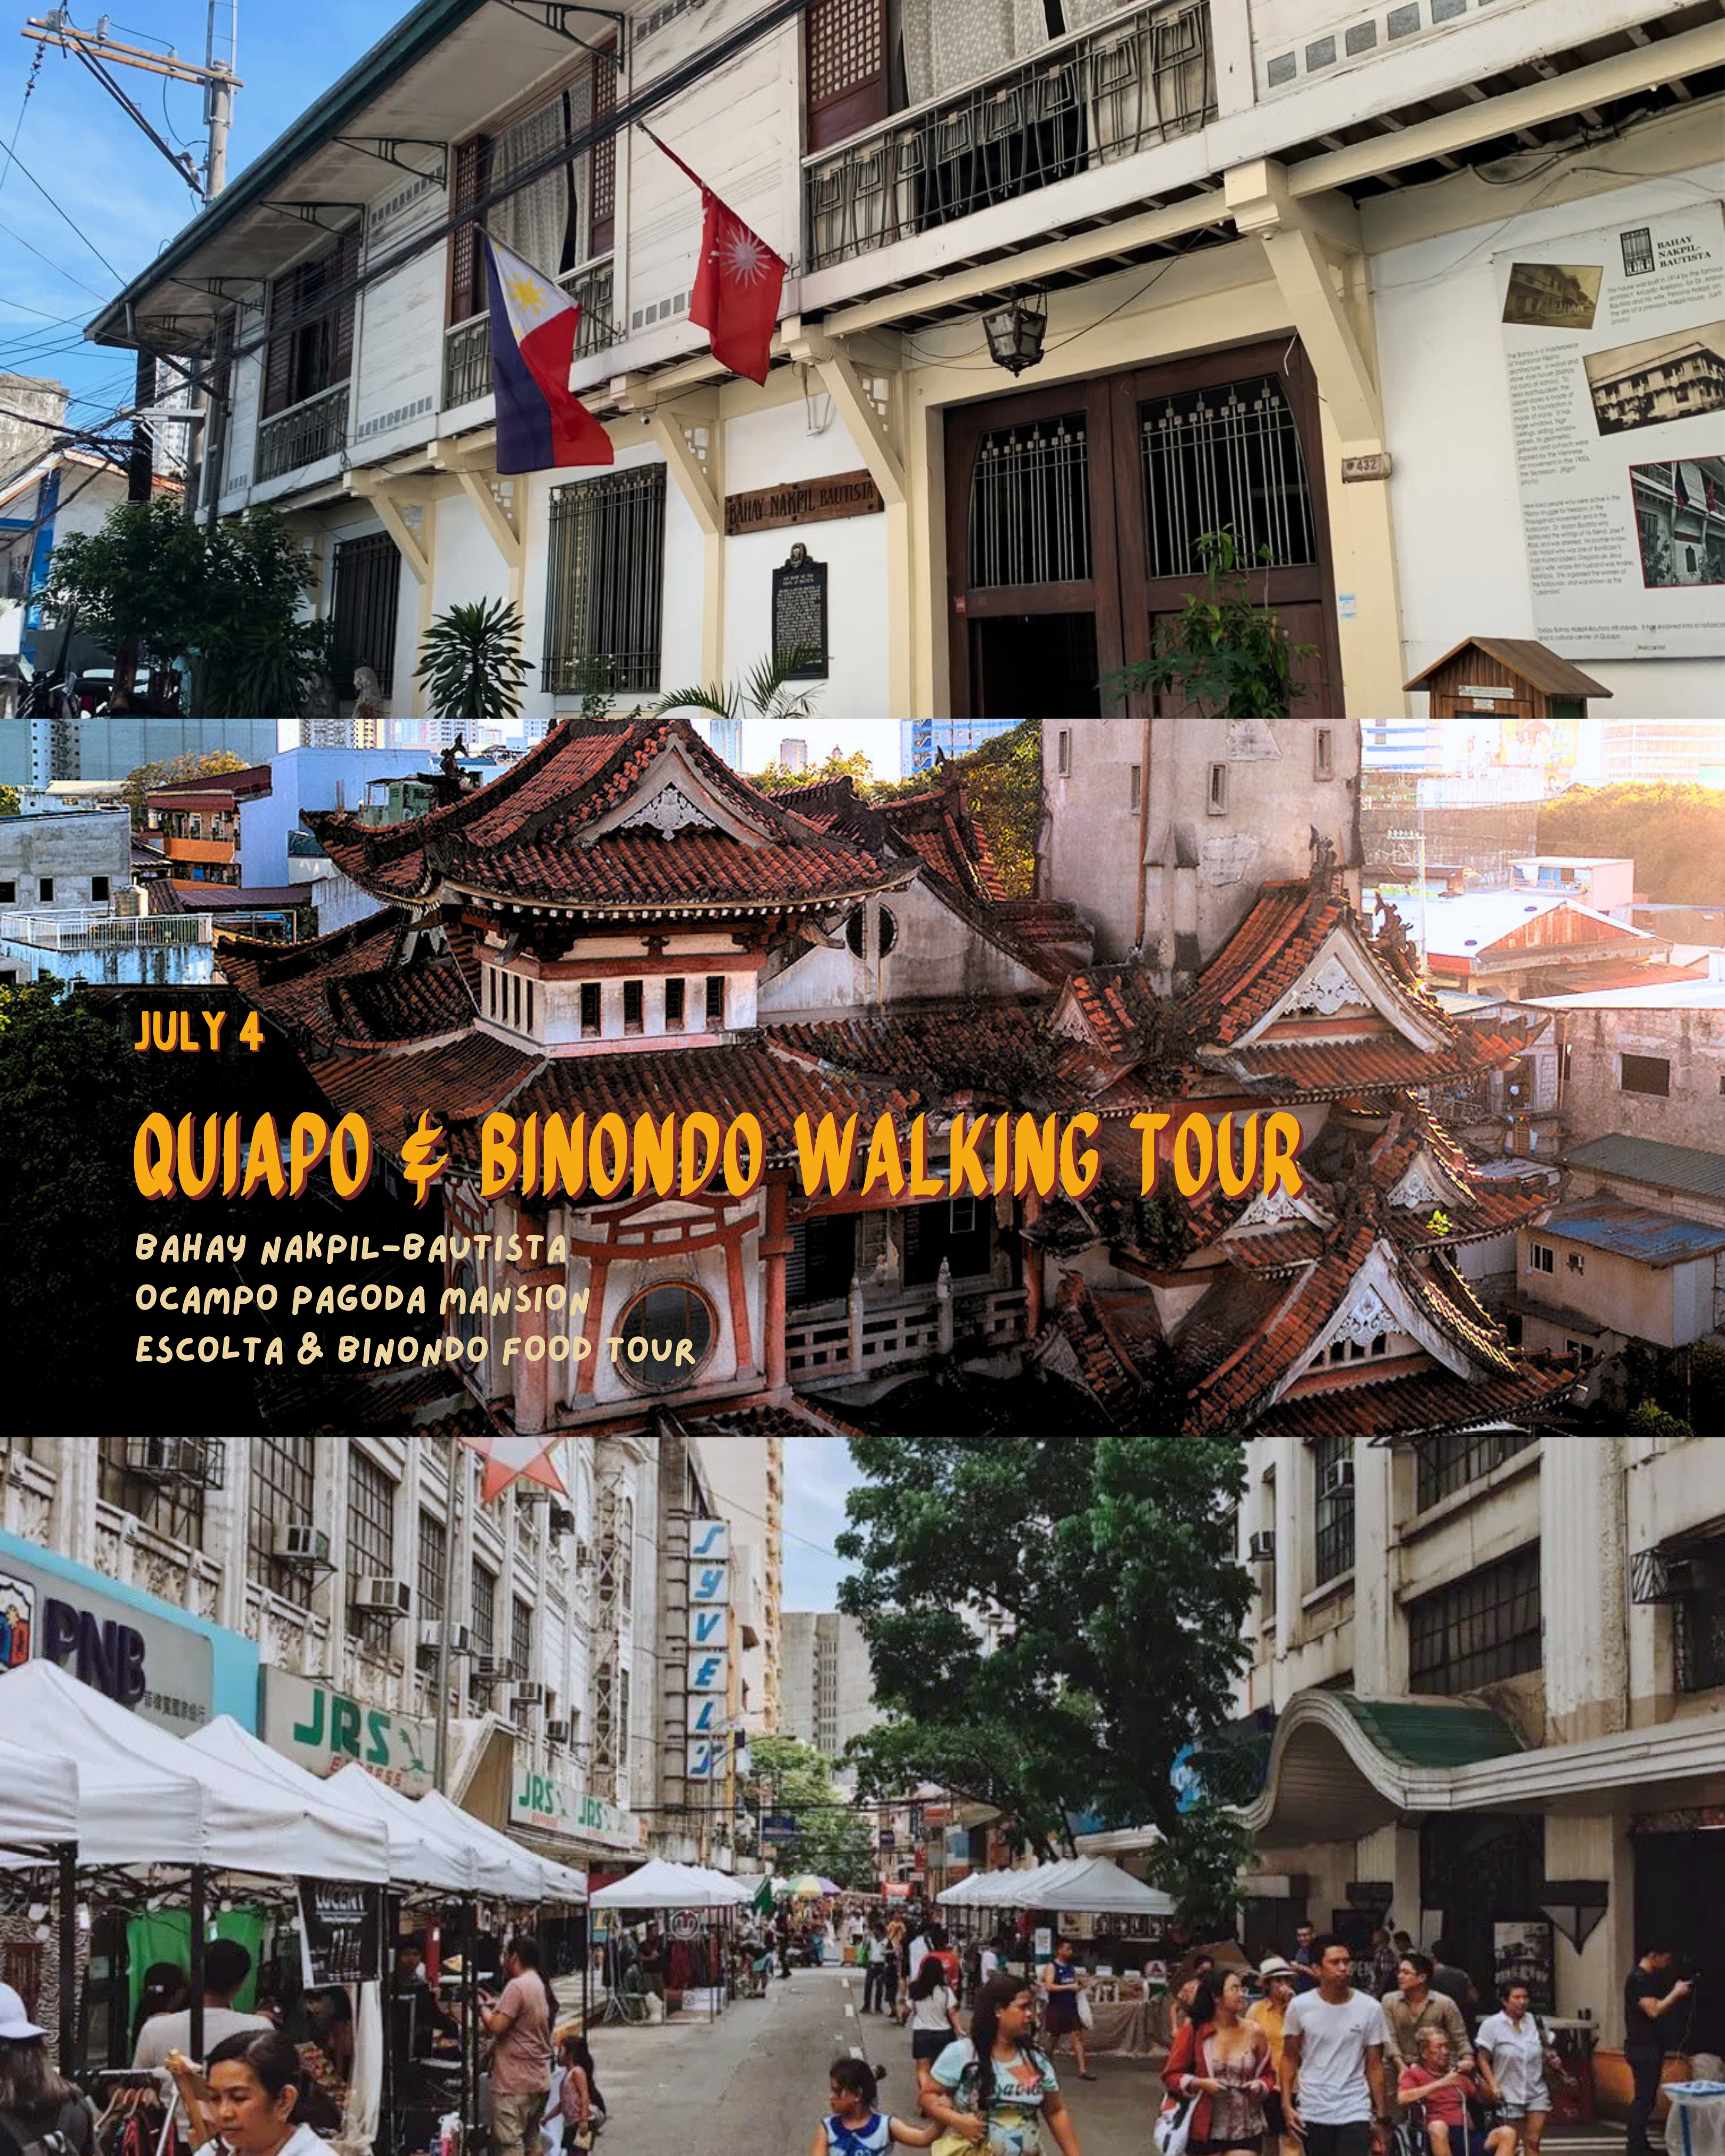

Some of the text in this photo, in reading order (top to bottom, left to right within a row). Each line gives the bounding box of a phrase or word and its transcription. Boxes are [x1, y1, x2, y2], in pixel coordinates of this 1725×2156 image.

[1657, 235, 1693, 250] BAHAY
[1658, 244, 1701, 259] NAKPIL-
[1660, 251, 1712, 267] BAUTISTA
[730, 480, 874, 525] BAHAY NAKPIL BAUTISTA
[43, 1598, 145, 1704] PNB
[294, 1688, 391, 1767] JRS
[519, 1772, 553, 1814] JRS
[578, 1796, 602, 1829] JRS
